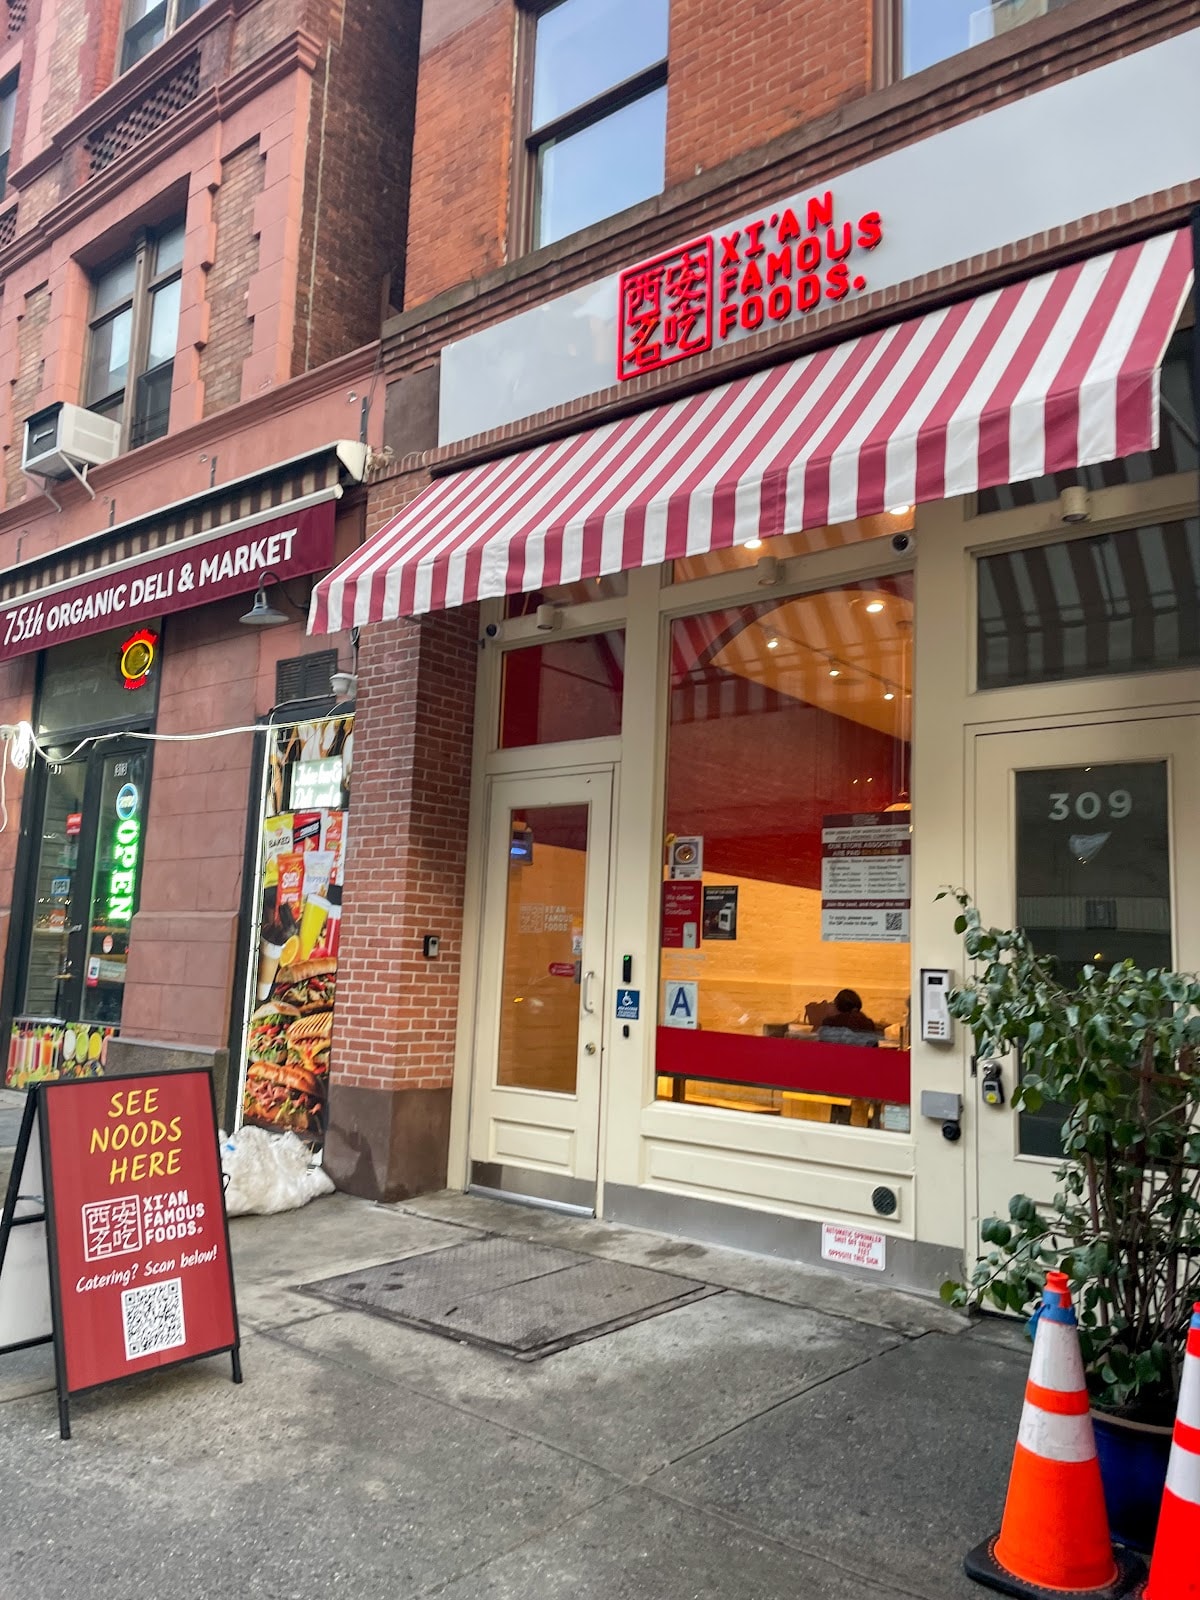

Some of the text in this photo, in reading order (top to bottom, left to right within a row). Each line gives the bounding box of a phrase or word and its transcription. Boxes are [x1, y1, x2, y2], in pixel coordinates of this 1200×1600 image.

[720, 190, 833, 268] XI'AN
[719, 211, 883, 304] FAMOUS
[719, 263, 866, 339] FOODS.
[3, 528, 298, 646] 75th ORGANIC DELI & MARKET
[1048, 789, 1132, 820] 309
[268, 835, 290, 848] BAKED
[109, 820, 140, 921] OPEN
[544, 914, 574, 922] FAMOUS
[670, 986, 691, 1017] A
[108, 1088, 159, 1118] SEE
[90, 1116, 182, 1154] NOODS
[109, 1148, 182, 1185] HERE
[142, 1189, 189, 1212] XI'AN
[144, 1202, 205, 1229] FAMOUS
[86, 1201, 137, 1234] 西安
[145, 1220, 204, 1245] FOODS.
[75, 1244, 218, 1293] Catering? Scan below!
